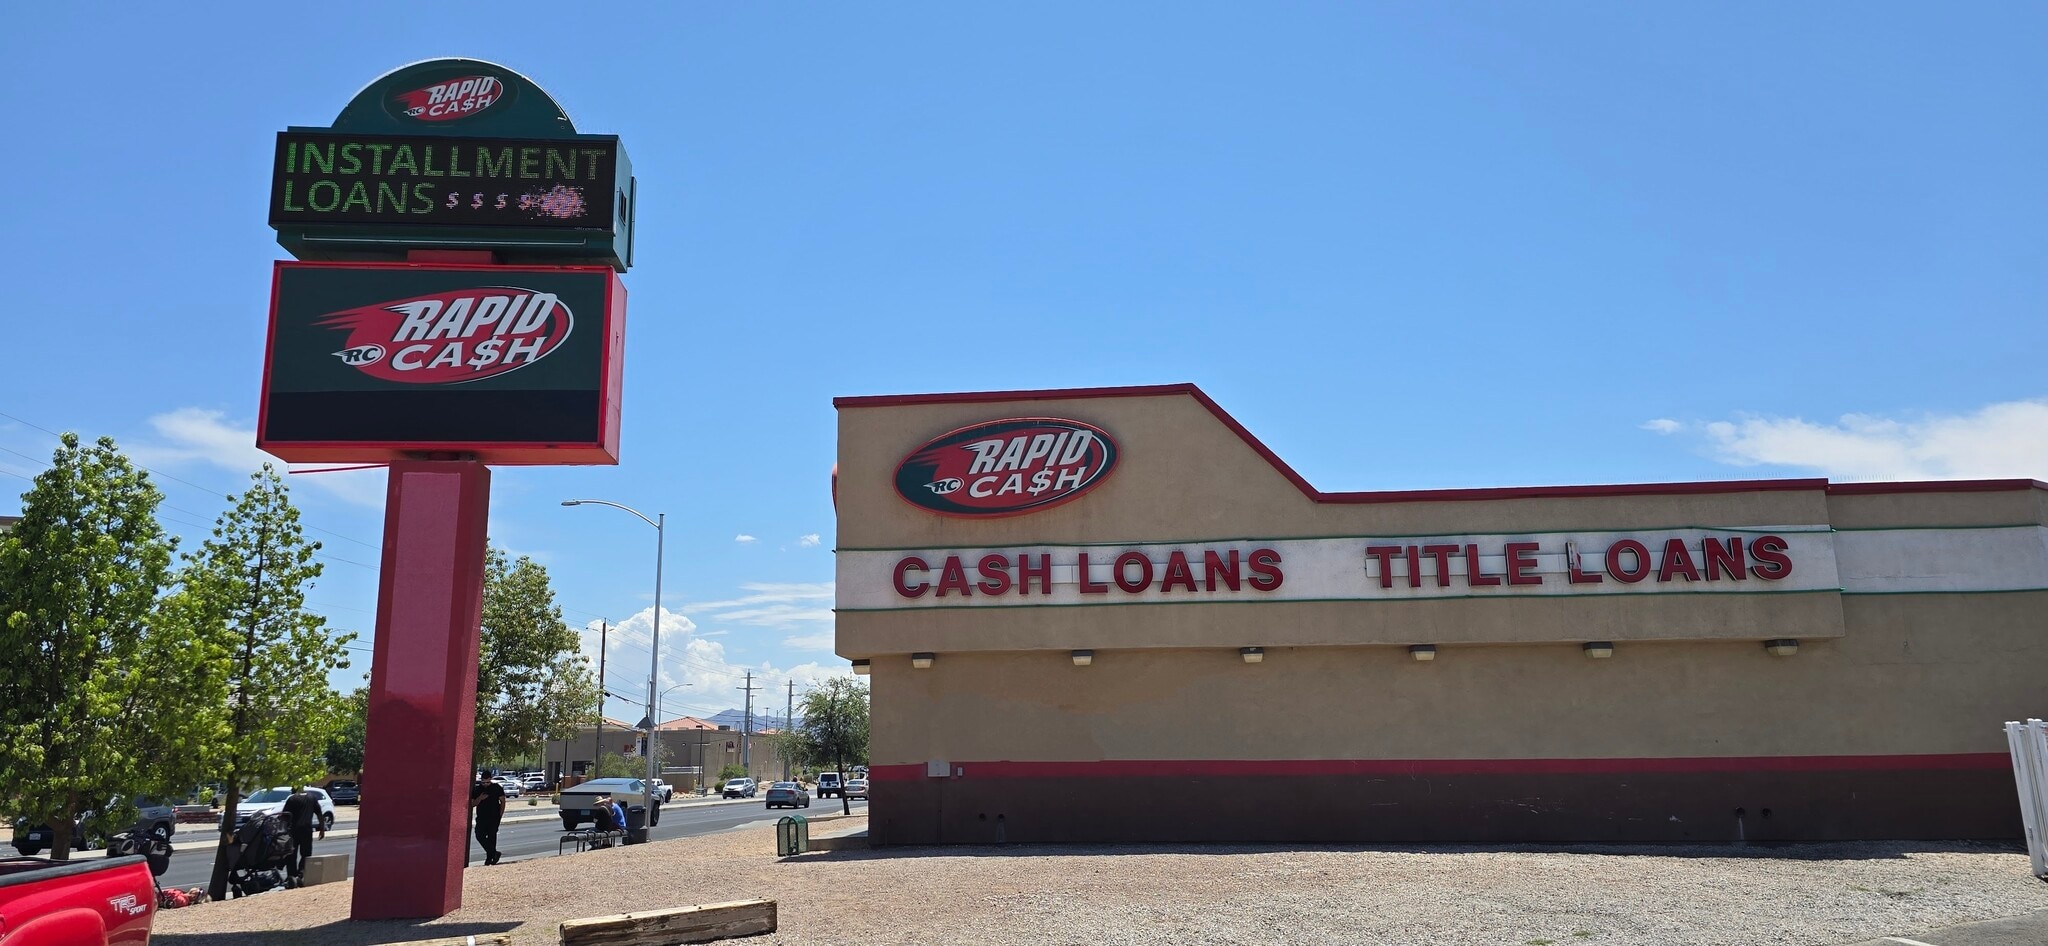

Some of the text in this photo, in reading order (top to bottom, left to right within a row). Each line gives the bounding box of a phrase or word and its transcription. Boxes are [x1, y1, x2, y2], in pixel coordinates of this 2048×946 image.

[424, 76, 495, 105] RAPID
[286, 142, 606, 180] INSTALLMENT
[283, 180, 435, 214] LOANS
[386, 293, 557, 342] RAPID
[346, 347, 379, 363] RC
[392, 336, 547, 371] CA$H
[962, 430, 1092, 475] RAPID
[933, 479, 959, 492] RC
[969, 466, 1087, 498] CA$H
[892, 548, 1285, 598] CASH LOANS
[1365, 535, 1793, 588] TITLE LOANS
[110, 894, 137, 913] TRD
[129, 903, 148, 915] SPORT
